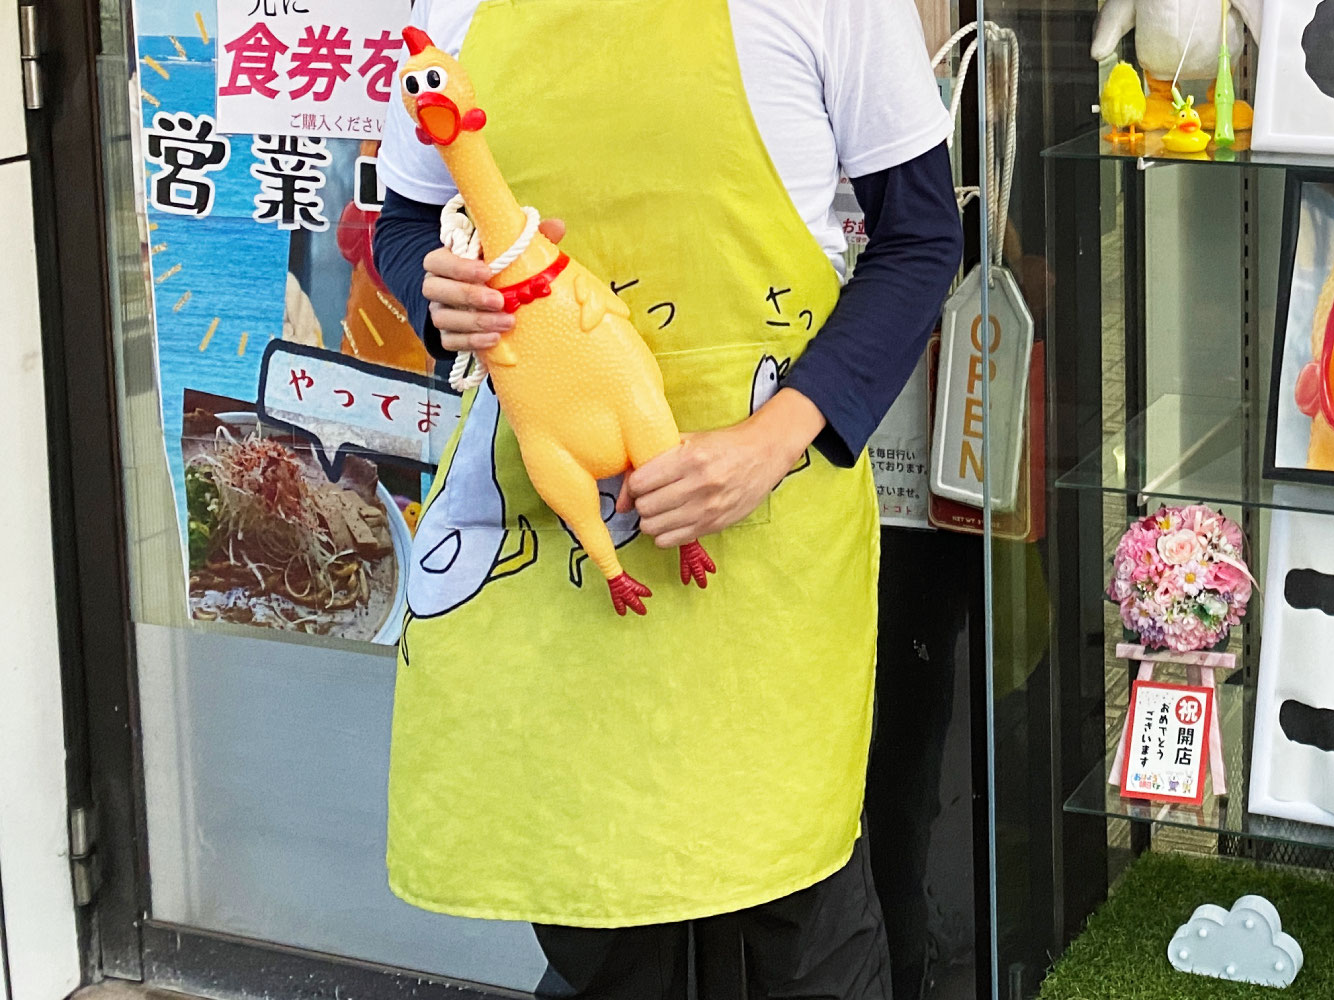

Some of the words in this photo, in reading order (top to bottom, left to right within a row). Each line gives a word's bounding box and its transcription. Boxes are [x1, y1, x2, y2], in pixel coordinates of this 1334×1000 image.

[218, 21, 402, 103] 食券を
[288, 368, 462, 433] やってま
[959, 313, 1001, 483] OPEN
